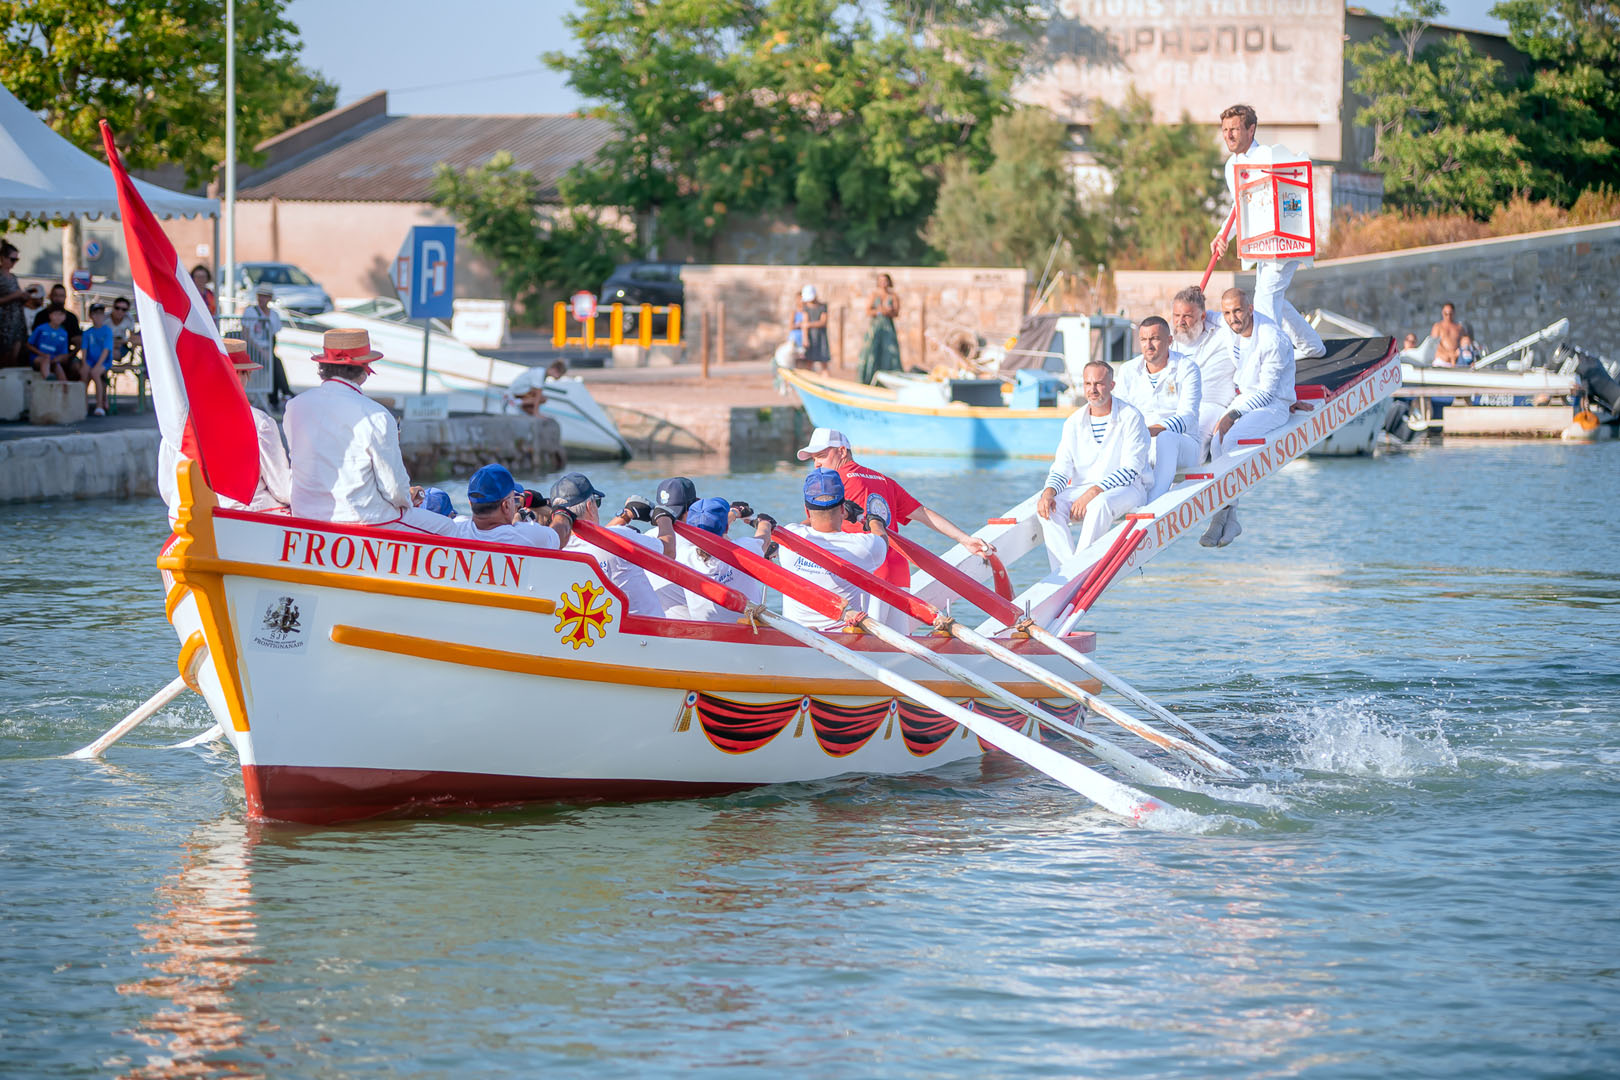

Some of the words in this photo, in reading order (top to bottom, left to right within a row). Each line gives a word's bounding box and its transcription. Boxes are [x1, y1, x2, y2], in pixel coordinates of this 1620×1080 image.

[420, 240, 447, 304] P
[1247, 237, 1305, 252] FRONTIGNAN
[1154, 446, 1273, 548] FRONTIGNAN
[1275, 422, 1309, 466] SON
[1312, 377, 1377, 443] MUSCAT
[279, 529, 525, 589] FRONTIGNAN
[253, 636, 304, 649] FRONTIGNANAIS
